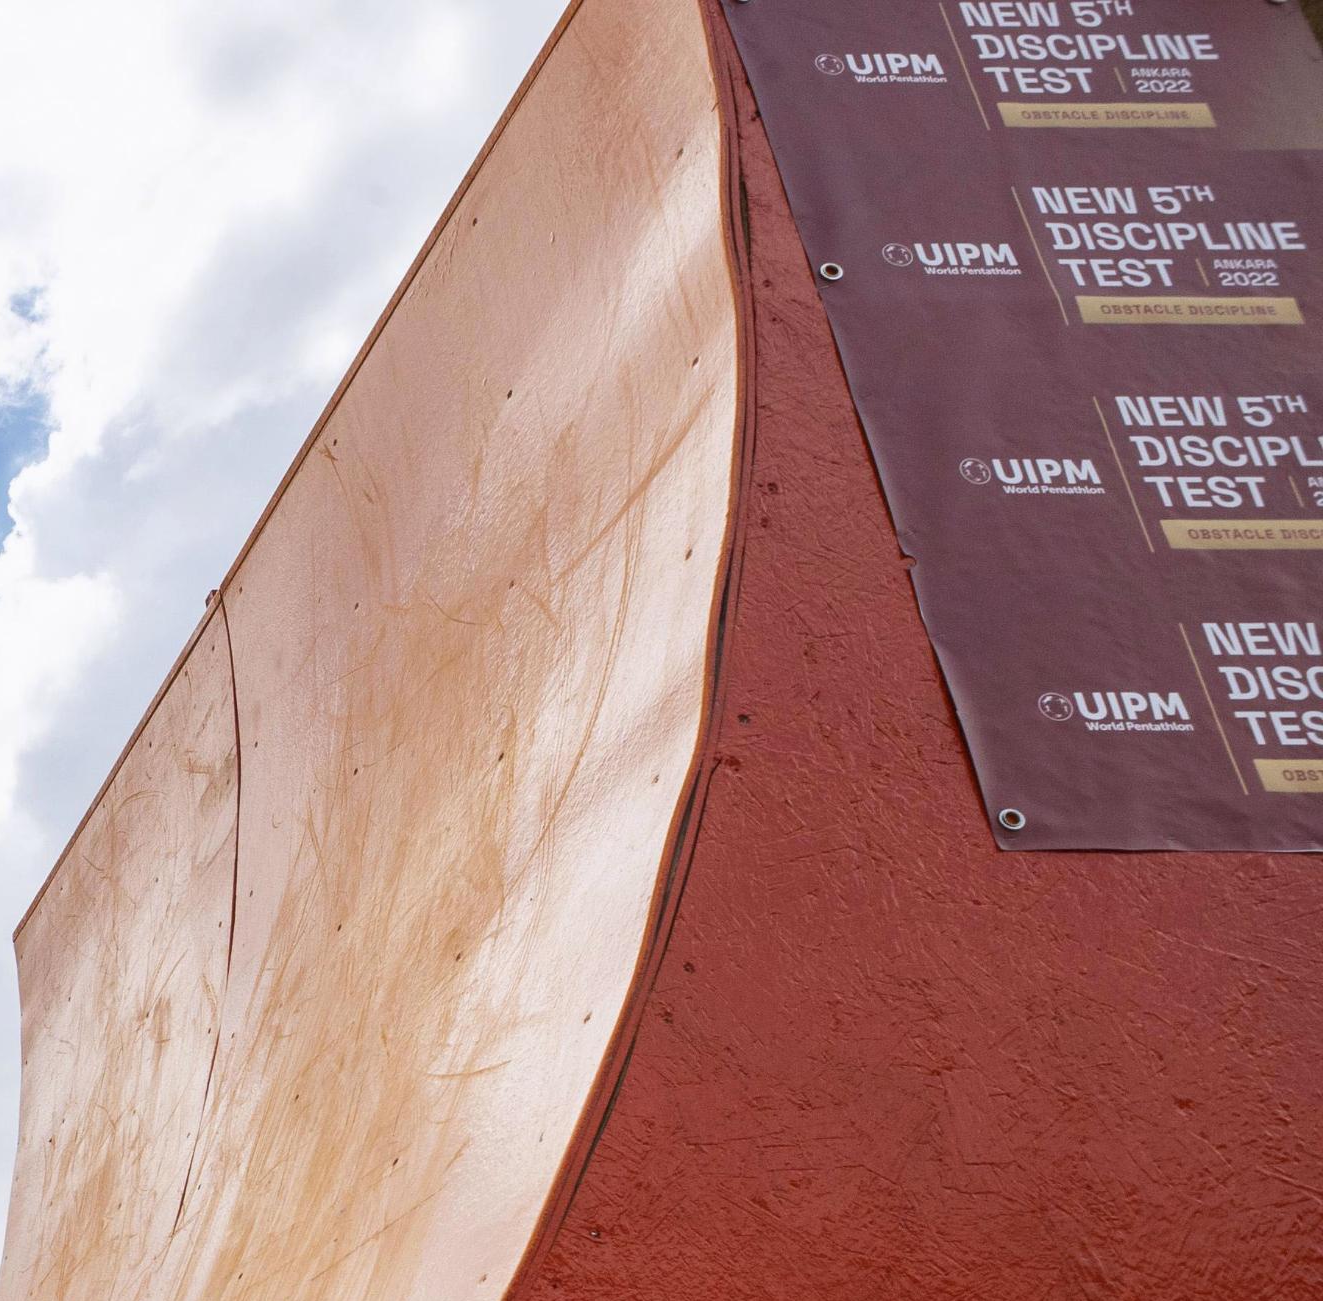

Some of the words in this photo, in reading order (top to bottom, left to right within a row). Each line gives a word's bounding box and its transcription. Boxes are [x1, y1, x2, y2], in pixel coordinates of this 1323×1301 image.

[958, 2, 1058, 27] NEW
[1071, 0, 1134, 28] 5TH
[971, 34, 1220, 61] DISCIPLINE
[845, 53, 944, 75] UIPM
[1131, 67, 1192, 78] ANKARA
[855, 75, 888, 83] World
[889, 75, 948, 83] Pentathlon
[982, 67, 1093, 94] TEST
[1136, 80, 1193, 94] 2022
[1021, 110, 1099, 121] OBSTACLE
[1105, 110, 1191, 121] DISCIPLINE
[1032, 186, 1138, 215] NEW
[1148, 185, 1215, 215] 5TH
[1045, 222, 1306, 251] DISCIPLINE
[914, 243, 1019, 266] UIPM
[1214, 258, 1278, 270] ANKARA
[924, 266, 959, 275] World
[960, 267, 1022, 275] Pentathlon
[1058, 258, 1174, 288] TEST
[1218, 271, 1280, 287] 2022
[1100, 304, 1183, 316] OBSTACLE
[1188, 304, 1277, 317] DISCIPLINE
[1115, 396, 1228, 427] NEW
[1236, 394, 1308, 428] 5TH
[1128, 435, 1323, 468] DISCIPL
[992, 458, 1102, 485] UIPM
[1003, 485, 1039, 495] World
[1041, 485, 1106, 495] Pentathlon
[1143, 475, 1266, 509] TEST
[1188, 528, 1274, 541] OBSTACLE
[1202, 622, 1323, 656] NEW
[1073, 691, 1191, 721] UIPM
[1085, 722, 1124, 732] World
[1126, 722, 1195, 732] Pentathlon
